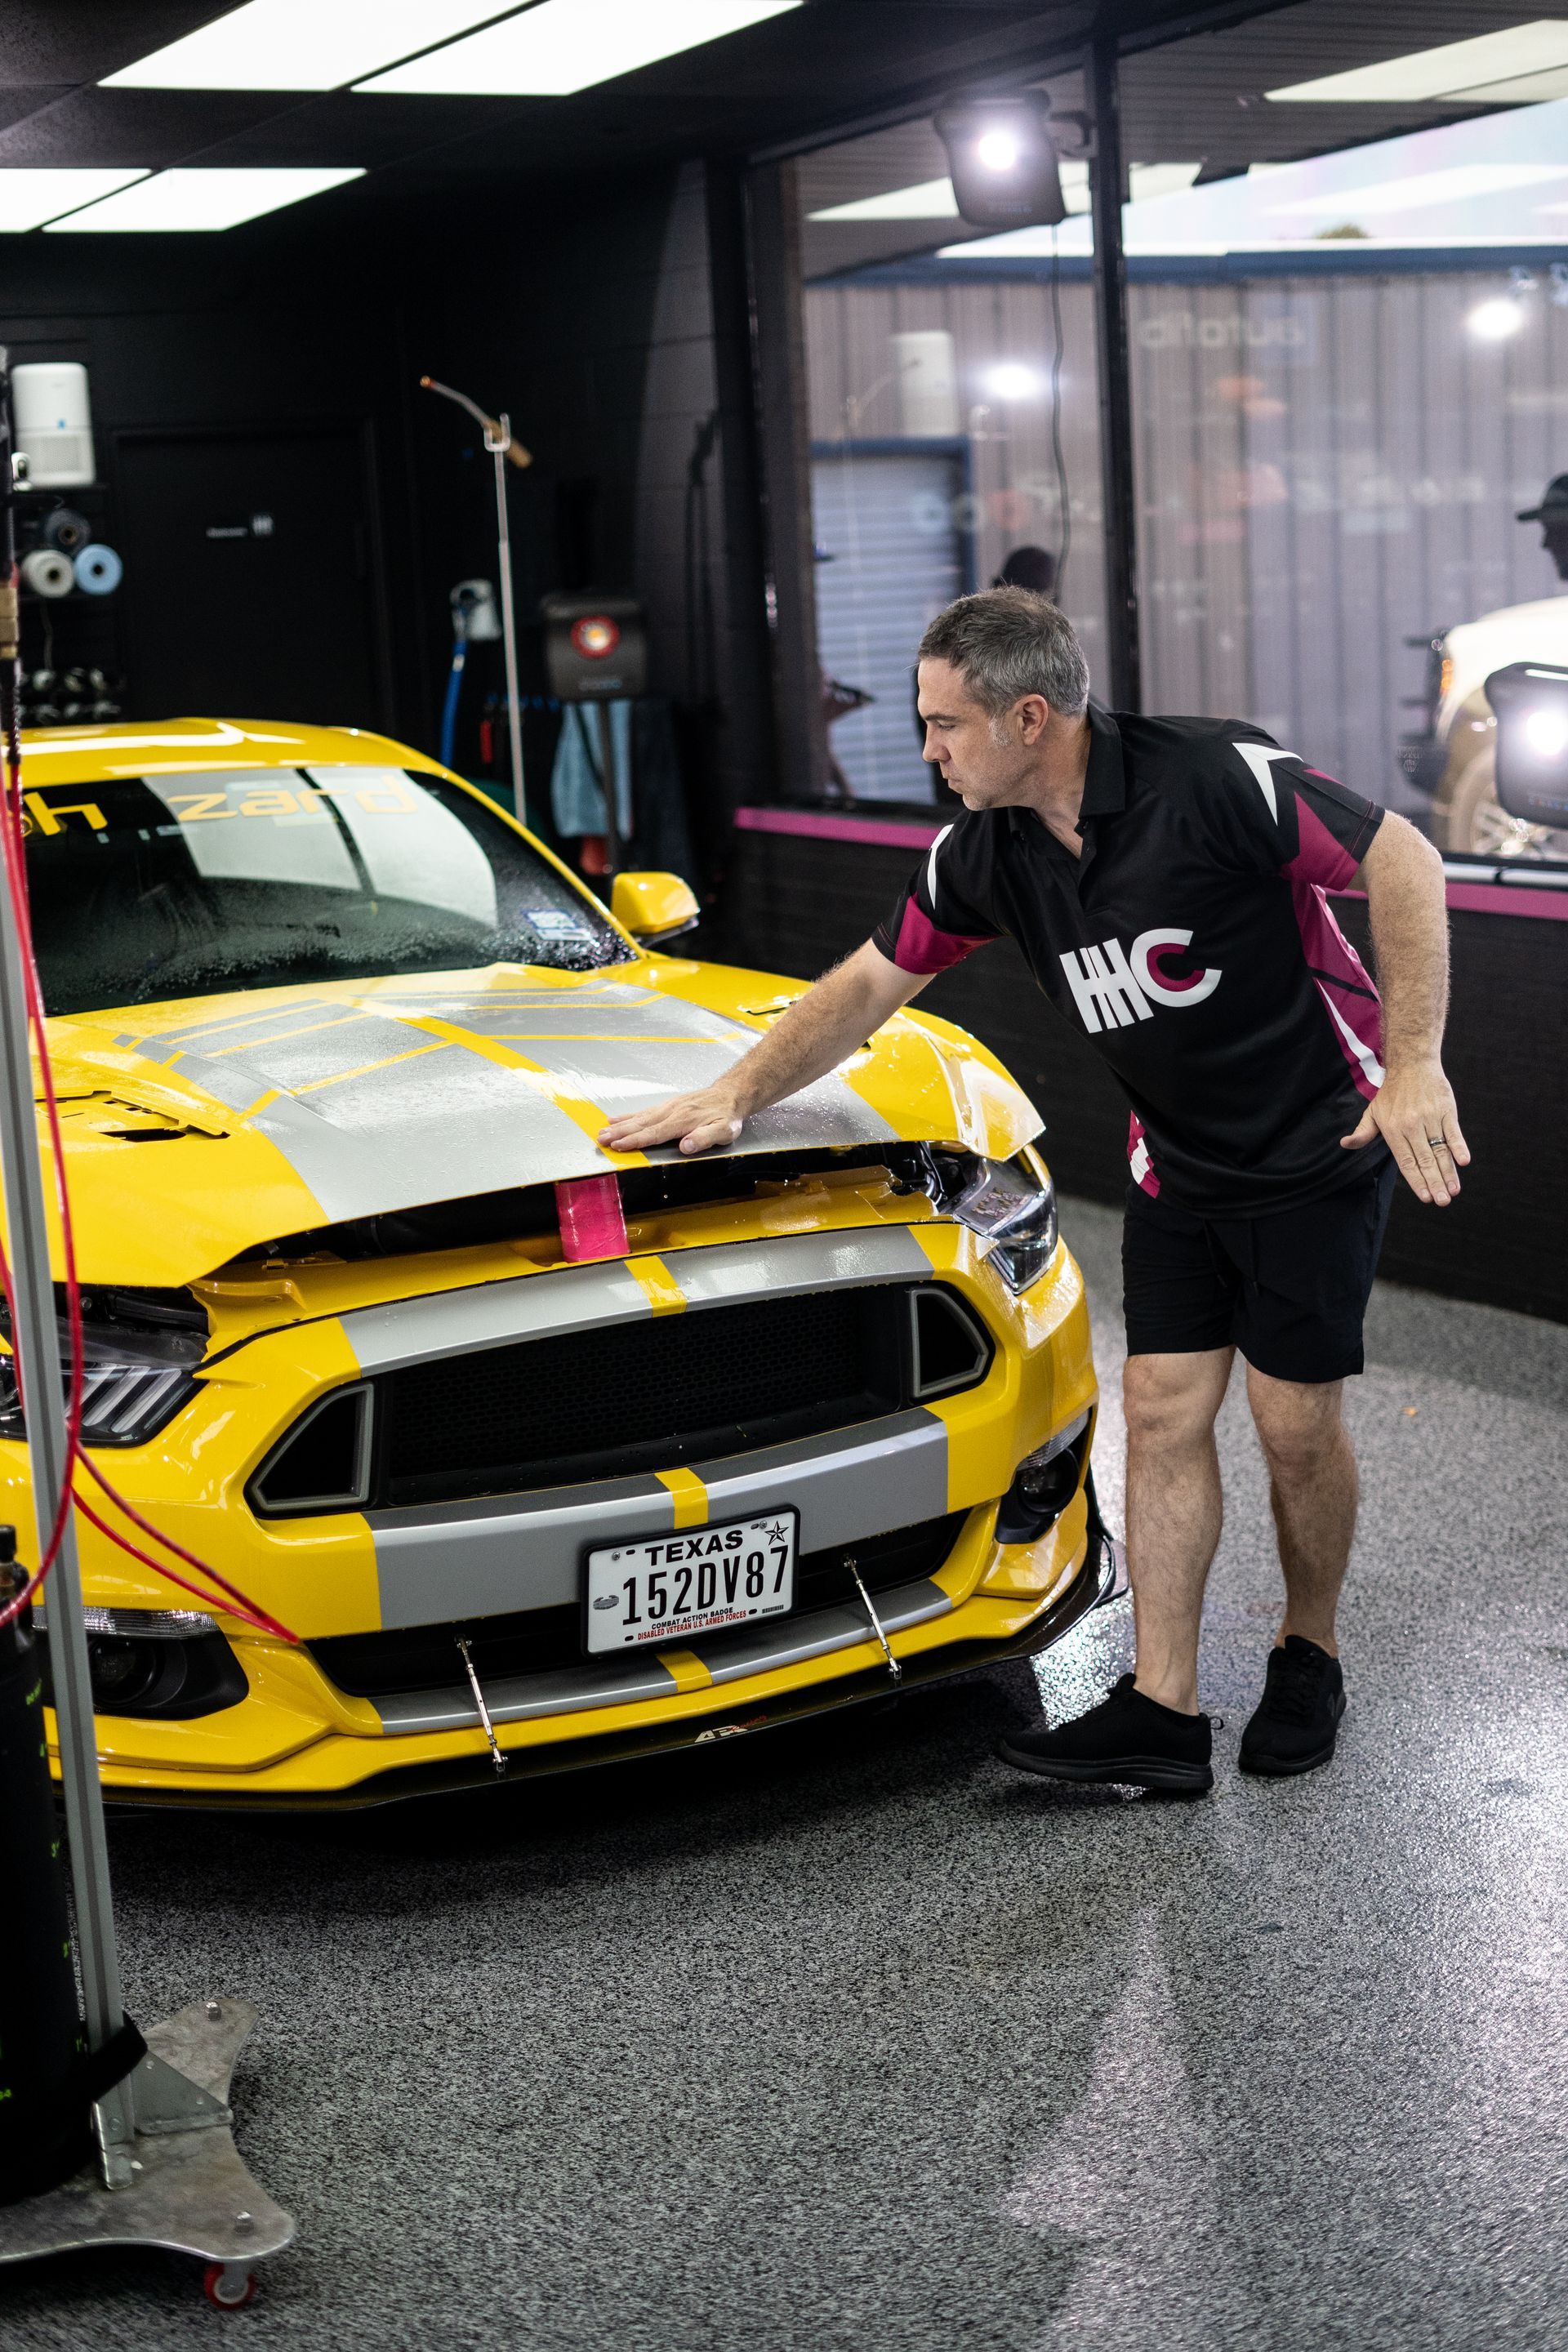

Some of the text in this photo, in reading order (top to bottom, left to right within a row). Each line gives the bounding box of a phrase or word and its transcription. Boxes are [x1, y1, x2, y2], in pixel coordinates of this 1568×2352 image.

[644, 1530, 743, 1566] TEXAS
[622, 1544, 789, 1626] 152DV87
[637, 1610, 746, 1641] DISABLED VETERAN U.S. ARMED FORCES
[652, 1606, 733, 1630] COMBAT ACTION BADGE
